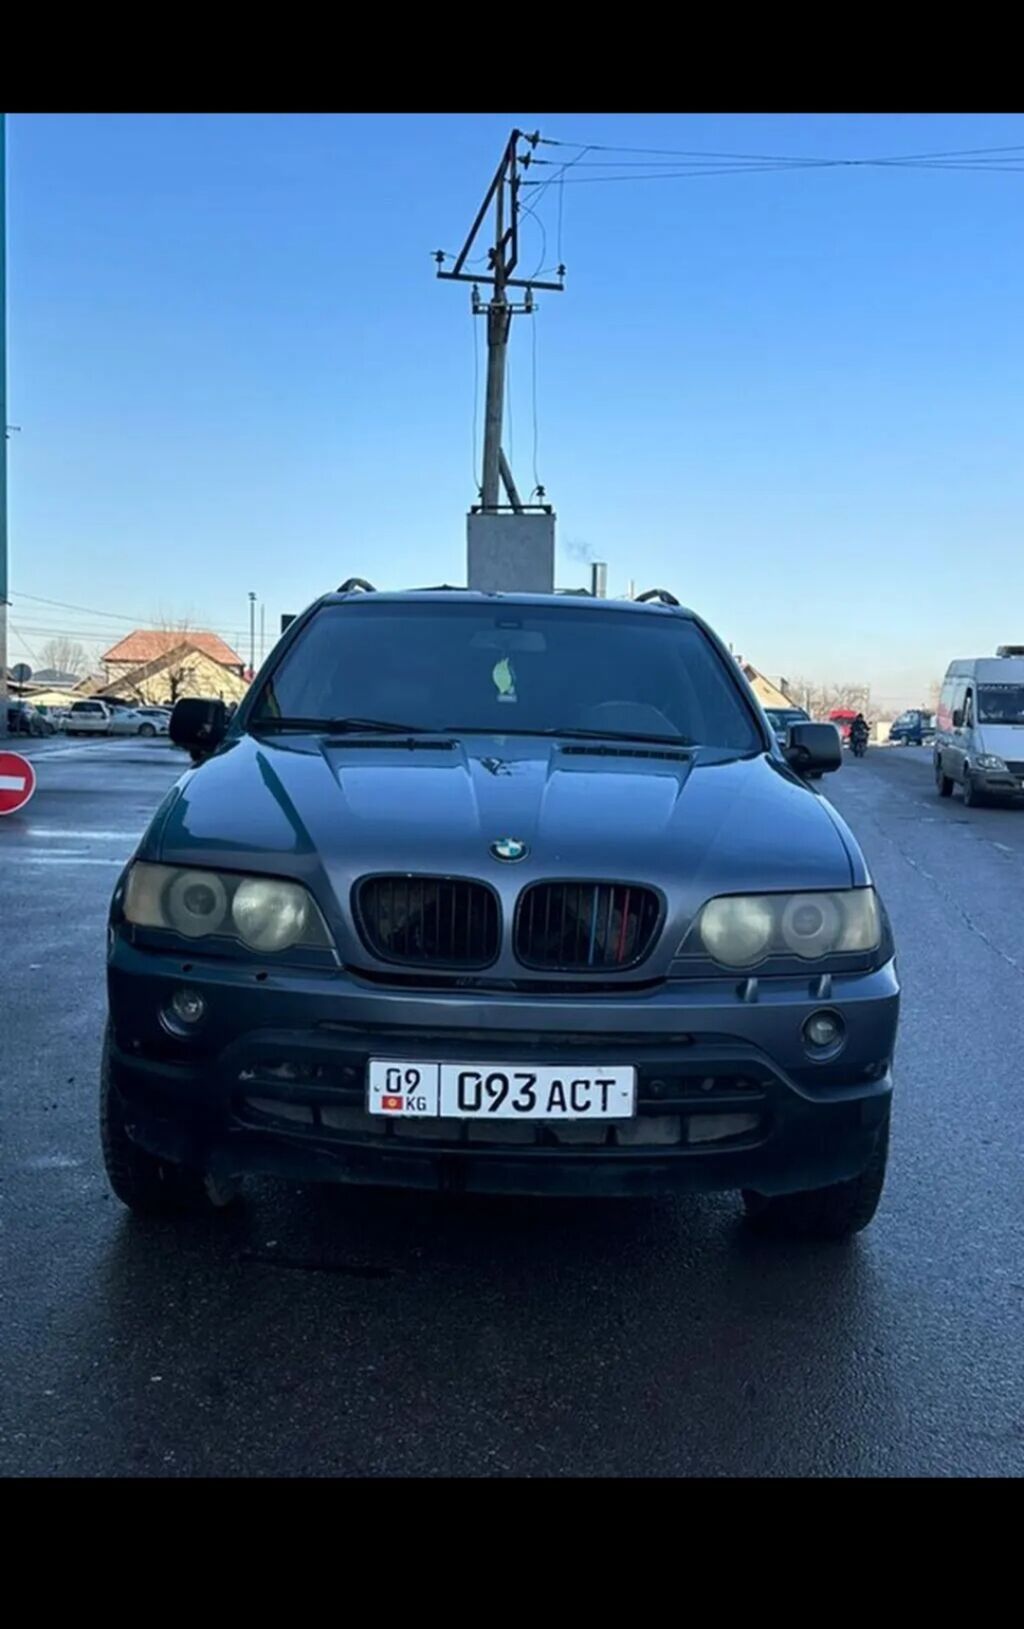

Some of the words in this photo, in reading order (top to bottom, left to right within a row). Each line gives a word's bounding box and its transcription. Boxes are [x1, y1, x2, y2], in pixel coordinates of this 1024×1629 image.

[386, 1067, 421, 1094] 09
[457, 1071, 537, 1113] 093
[546, 1079, 616, 1112] ACT
[405, 1096, 427, 1111] KG
